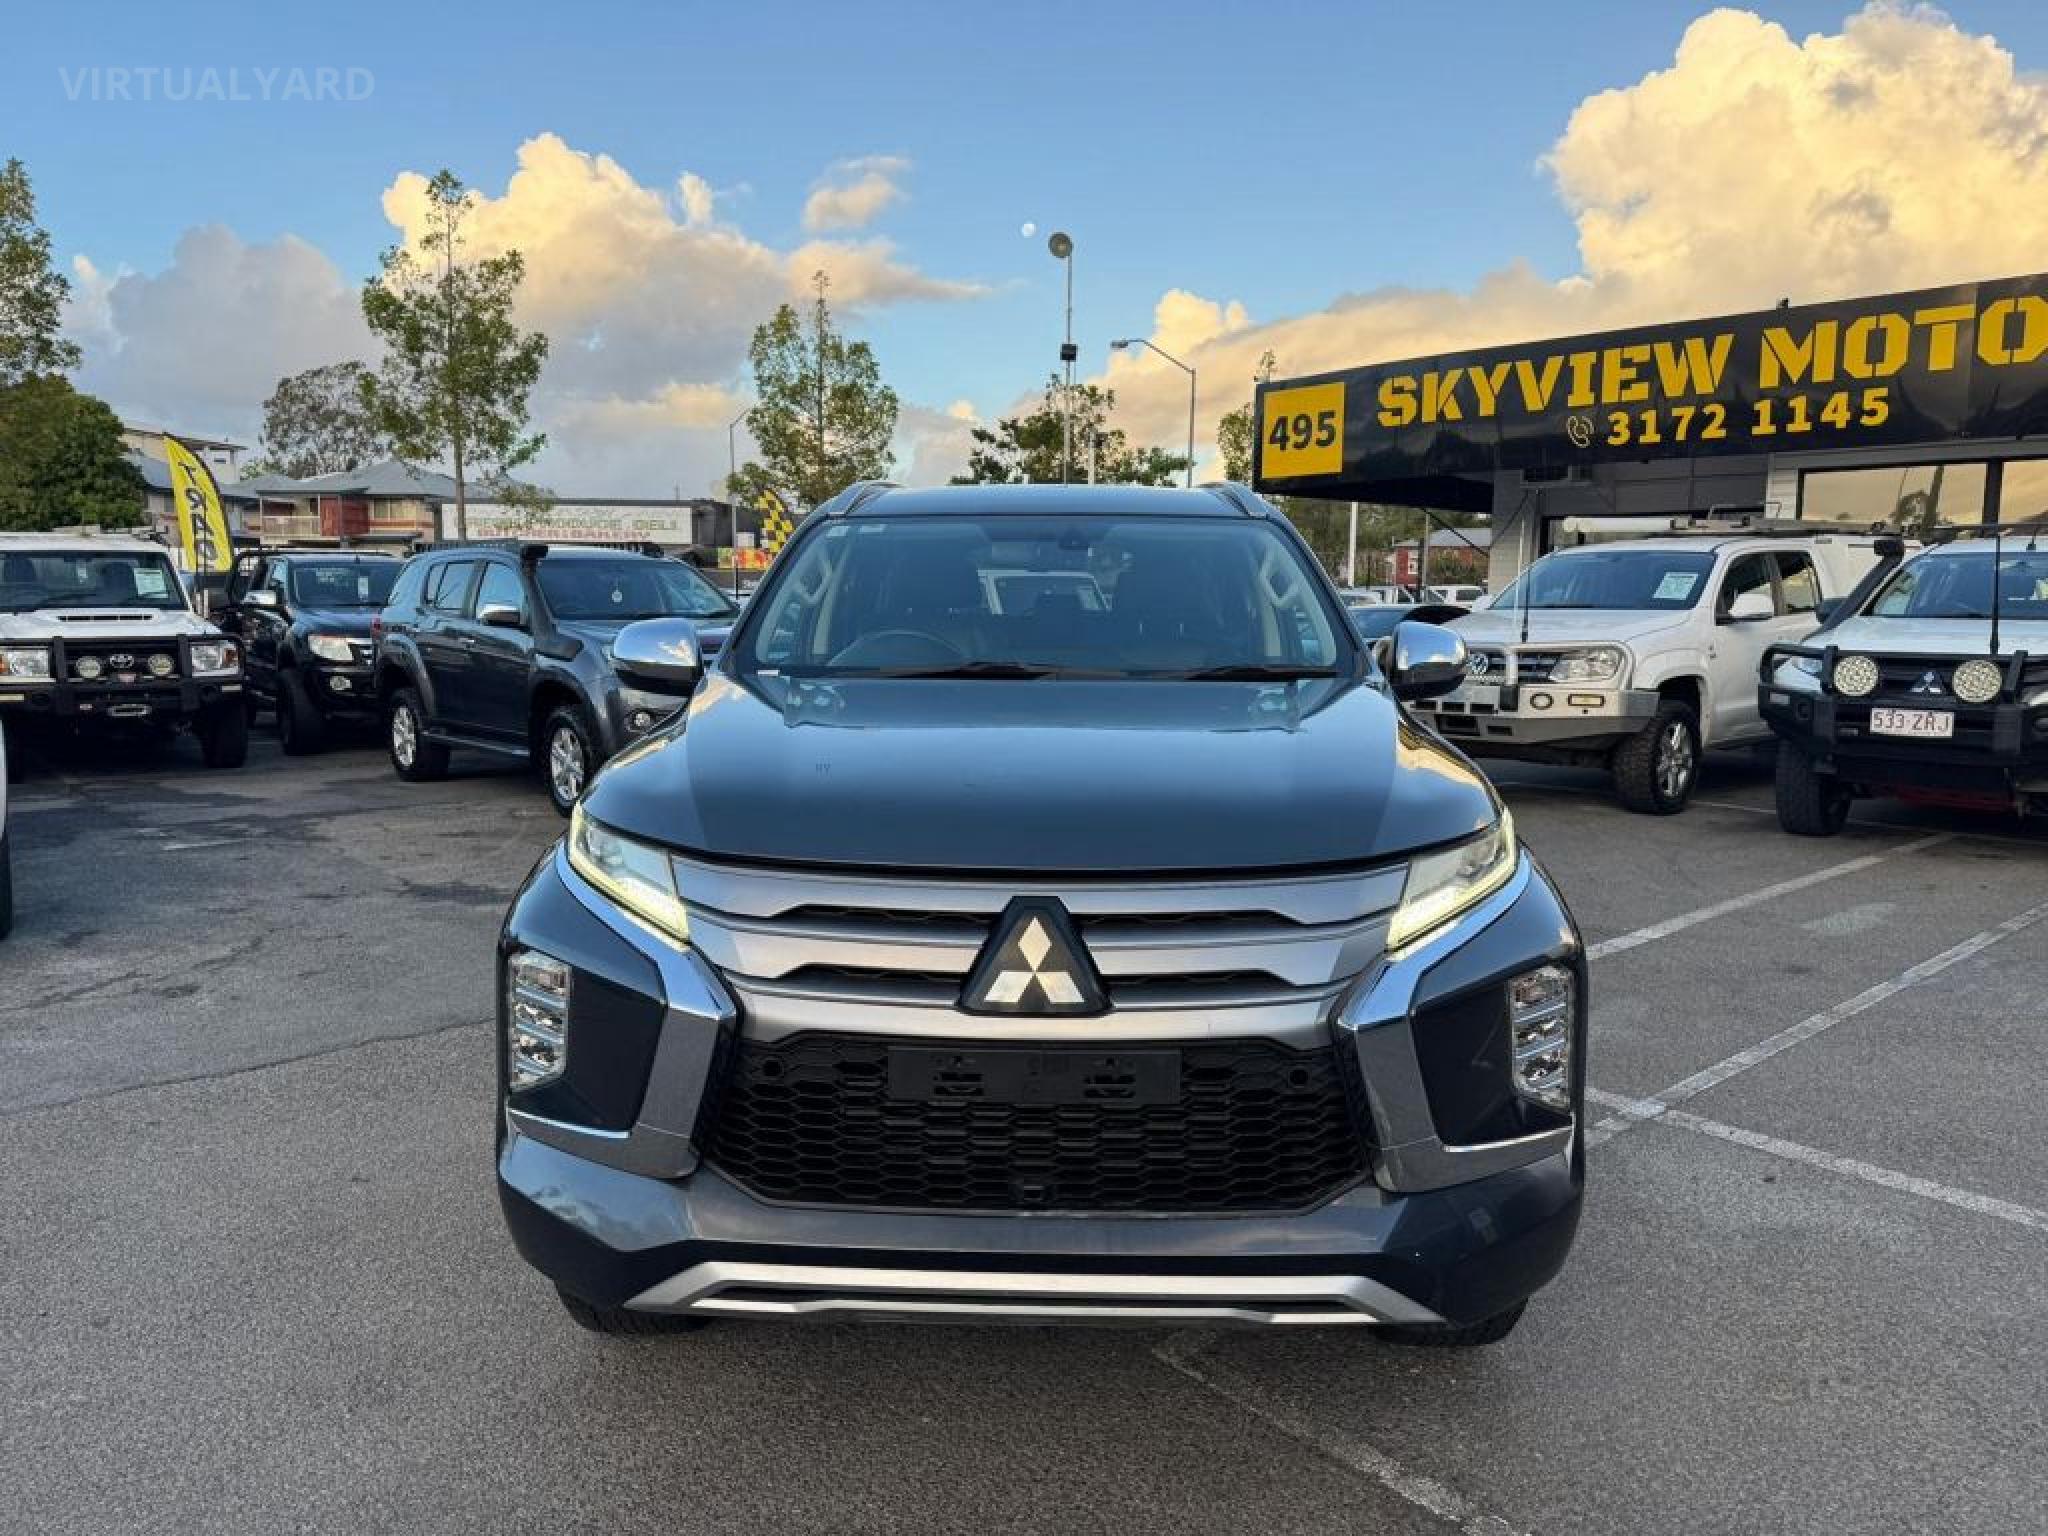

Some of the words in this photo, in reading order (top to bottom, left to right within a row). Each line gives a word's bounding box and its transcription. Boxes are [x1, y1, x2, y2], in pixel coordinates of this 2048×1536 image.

[1377, 333, 1734, 428] SKYVIEW
[1759, 295, 2048, 388] MOTO
[1268, 409, 1337, 451] 495
[1606, 402, 1728, 446] 3172
[1751, 387, 1890, 437] 1145
